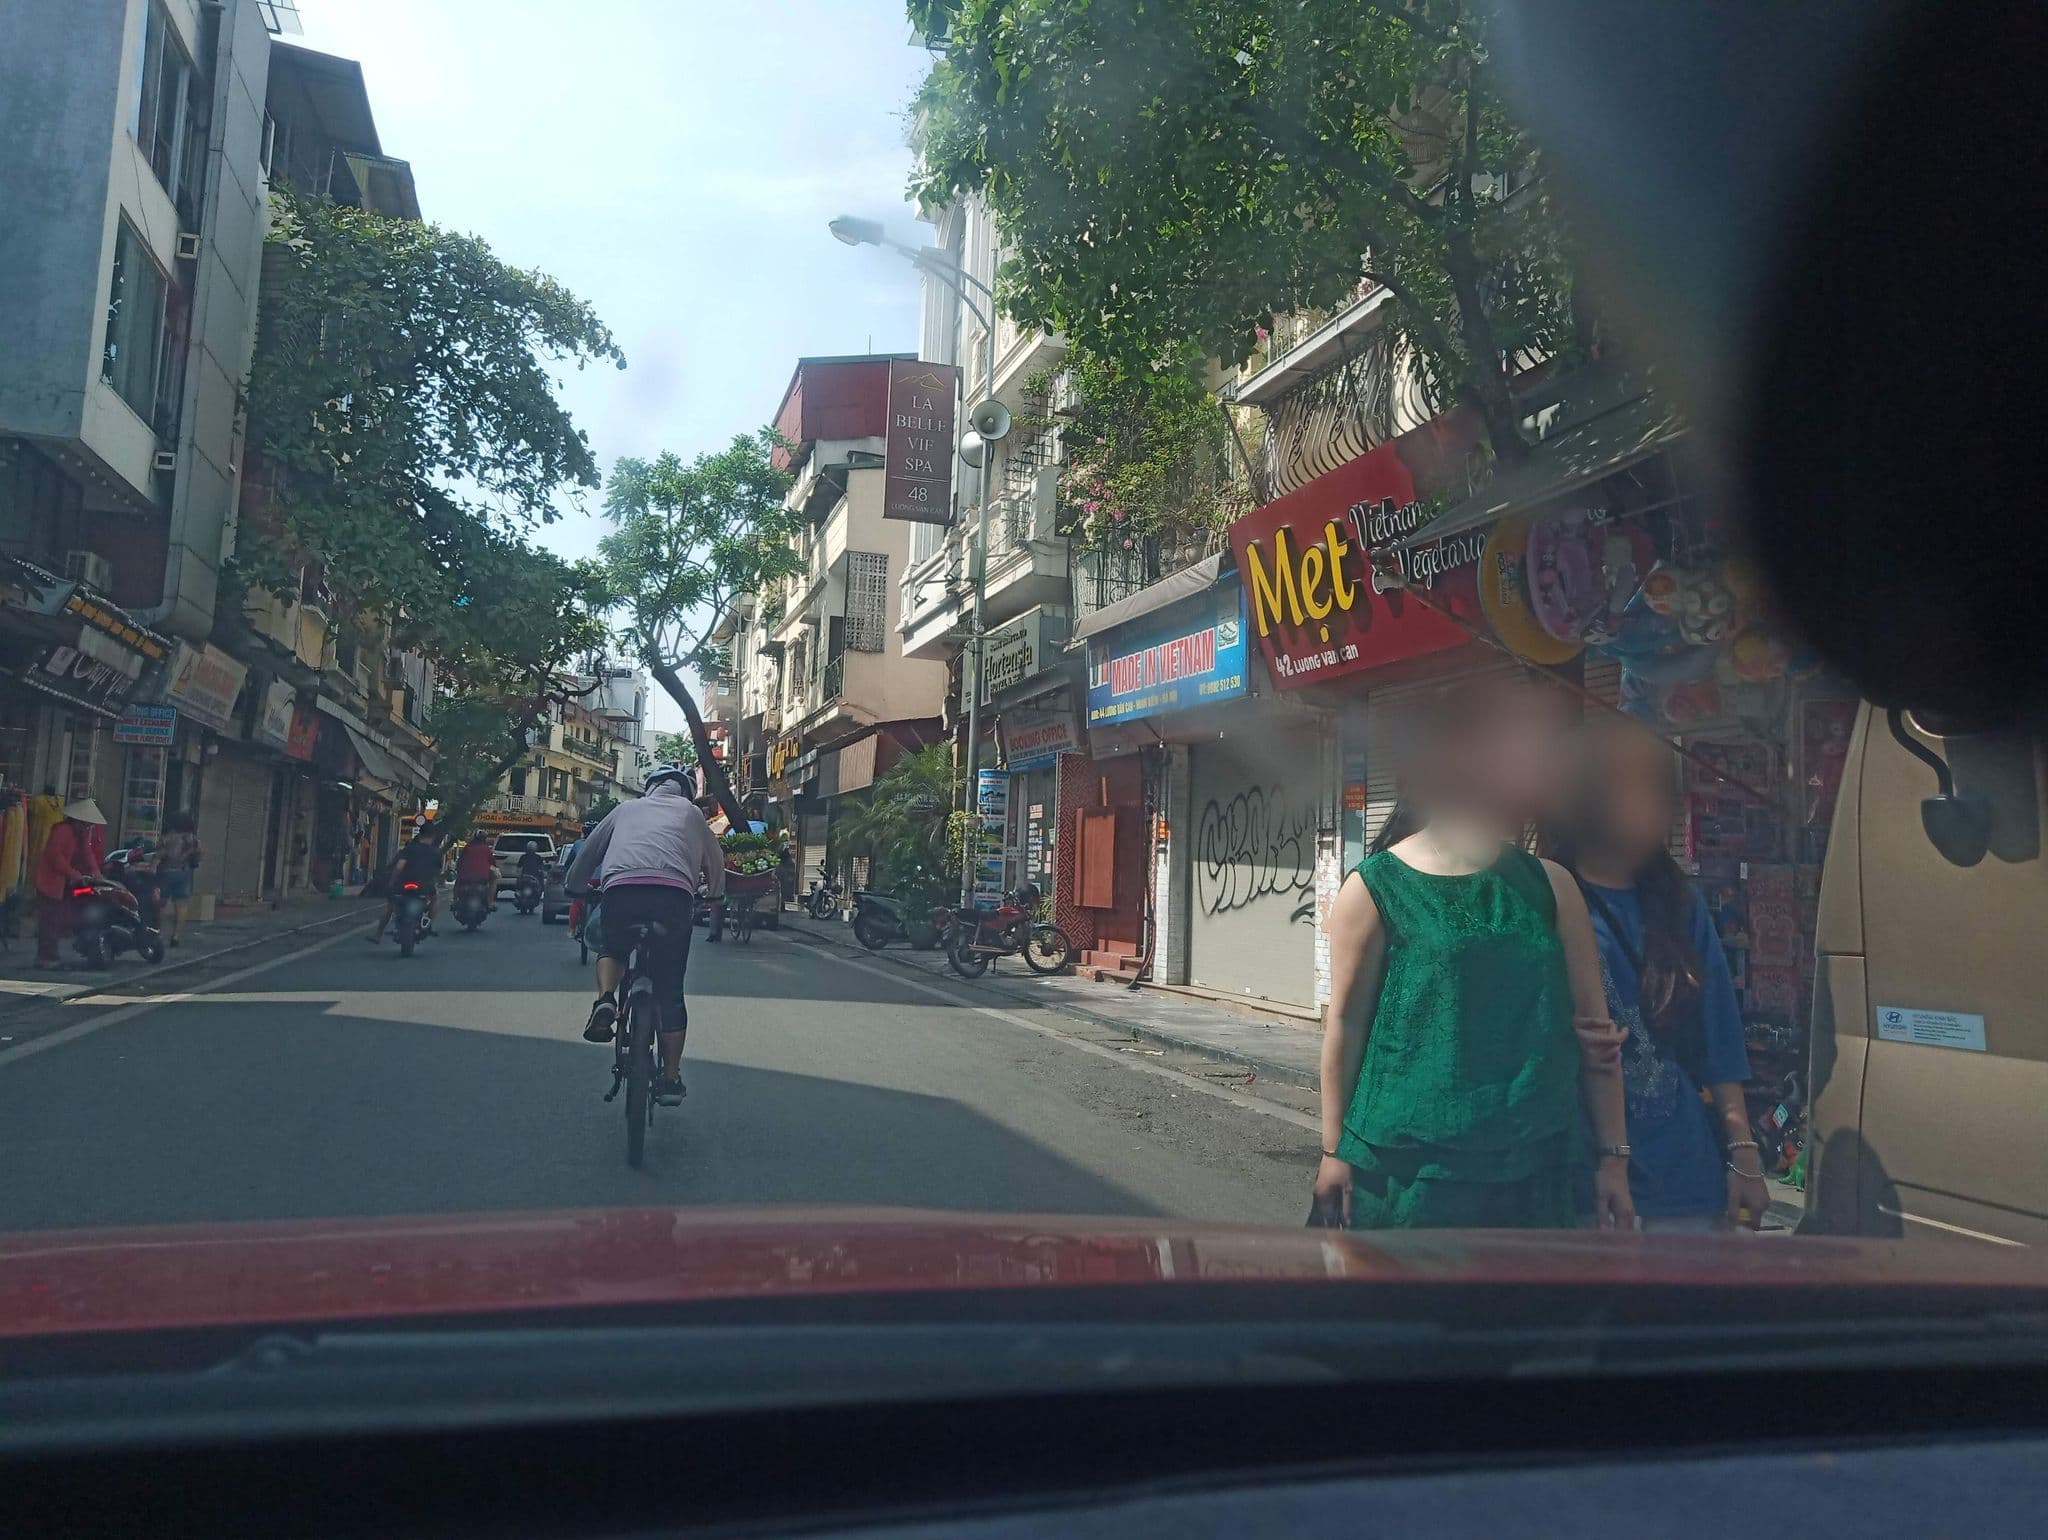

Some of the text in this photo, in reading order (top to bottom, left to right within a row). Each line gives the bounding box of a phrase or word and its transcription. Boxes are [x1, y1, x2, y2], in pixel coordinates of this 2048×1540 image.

[912, 396, 933, 410] LA
[896, 414, 947, 432] BELLE
[907, 436, 935, 451] VIE
[905, 457, 933, 473] SPA
[908, 486, 928, 502] 48
[1245, 517, 1356, 644] Mẹt
[1111, 628, 1216, 697] MADE IN VIETNAM
[1275, 654, 1294, 677] 42
